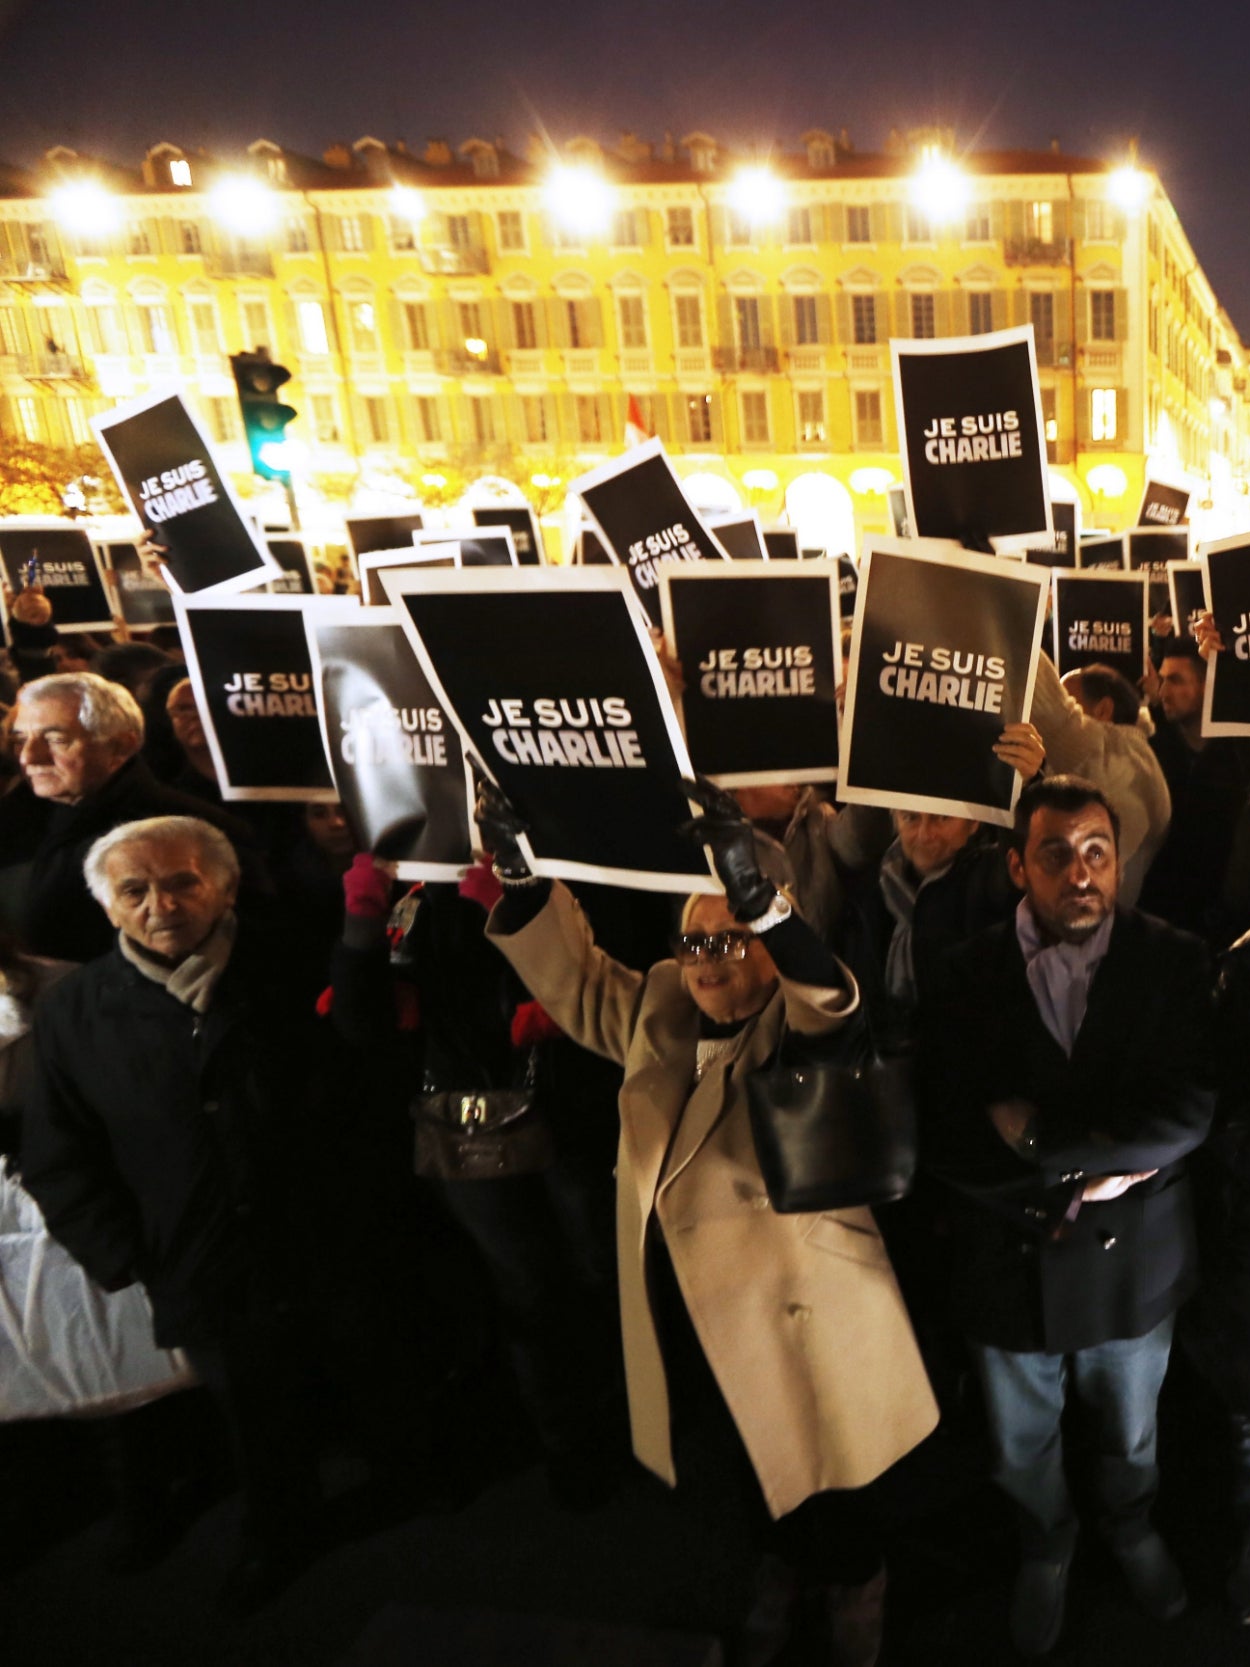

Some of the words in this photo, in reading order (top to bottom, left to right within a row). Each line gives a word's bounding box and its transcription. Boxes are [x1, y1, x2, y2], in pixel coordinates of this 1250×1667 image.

[923, 417, 957, 438] JE
[961, 410, 1019, 435] SUIS
[924, 431, 1023, 465] CHARLIE
[139, 476, 163, 500] JE
[160, 459, 207, 490] SUIS
[144, 477, 219, 523] CHARLIE
[628, 540, 649, 566] JE
[645, 523, 690, 556] SUIS
[42, 561, 86, 574] SUIS
[1068, 620, 1089, 634] JE
[1092, 621, 1132, 635] SUIS
[1068, 634, 1132, 653] CHARLIE
[699, 649, 739, 672] JE
[743, 645, 814, 671] SUIS
[882, 641, 925, 667] JE
[930, 647, 1006, 680] SUIS
[223, 673, 265, 692] JE
[700, 667, 816, 699] CHARLIE
[879, 665, 1005, 715] CHARLIE
[481, 698, 532, 728] JE
[533, 697, 633, 729] SUIS
[491, 728, 648, 769] CHARLIE
